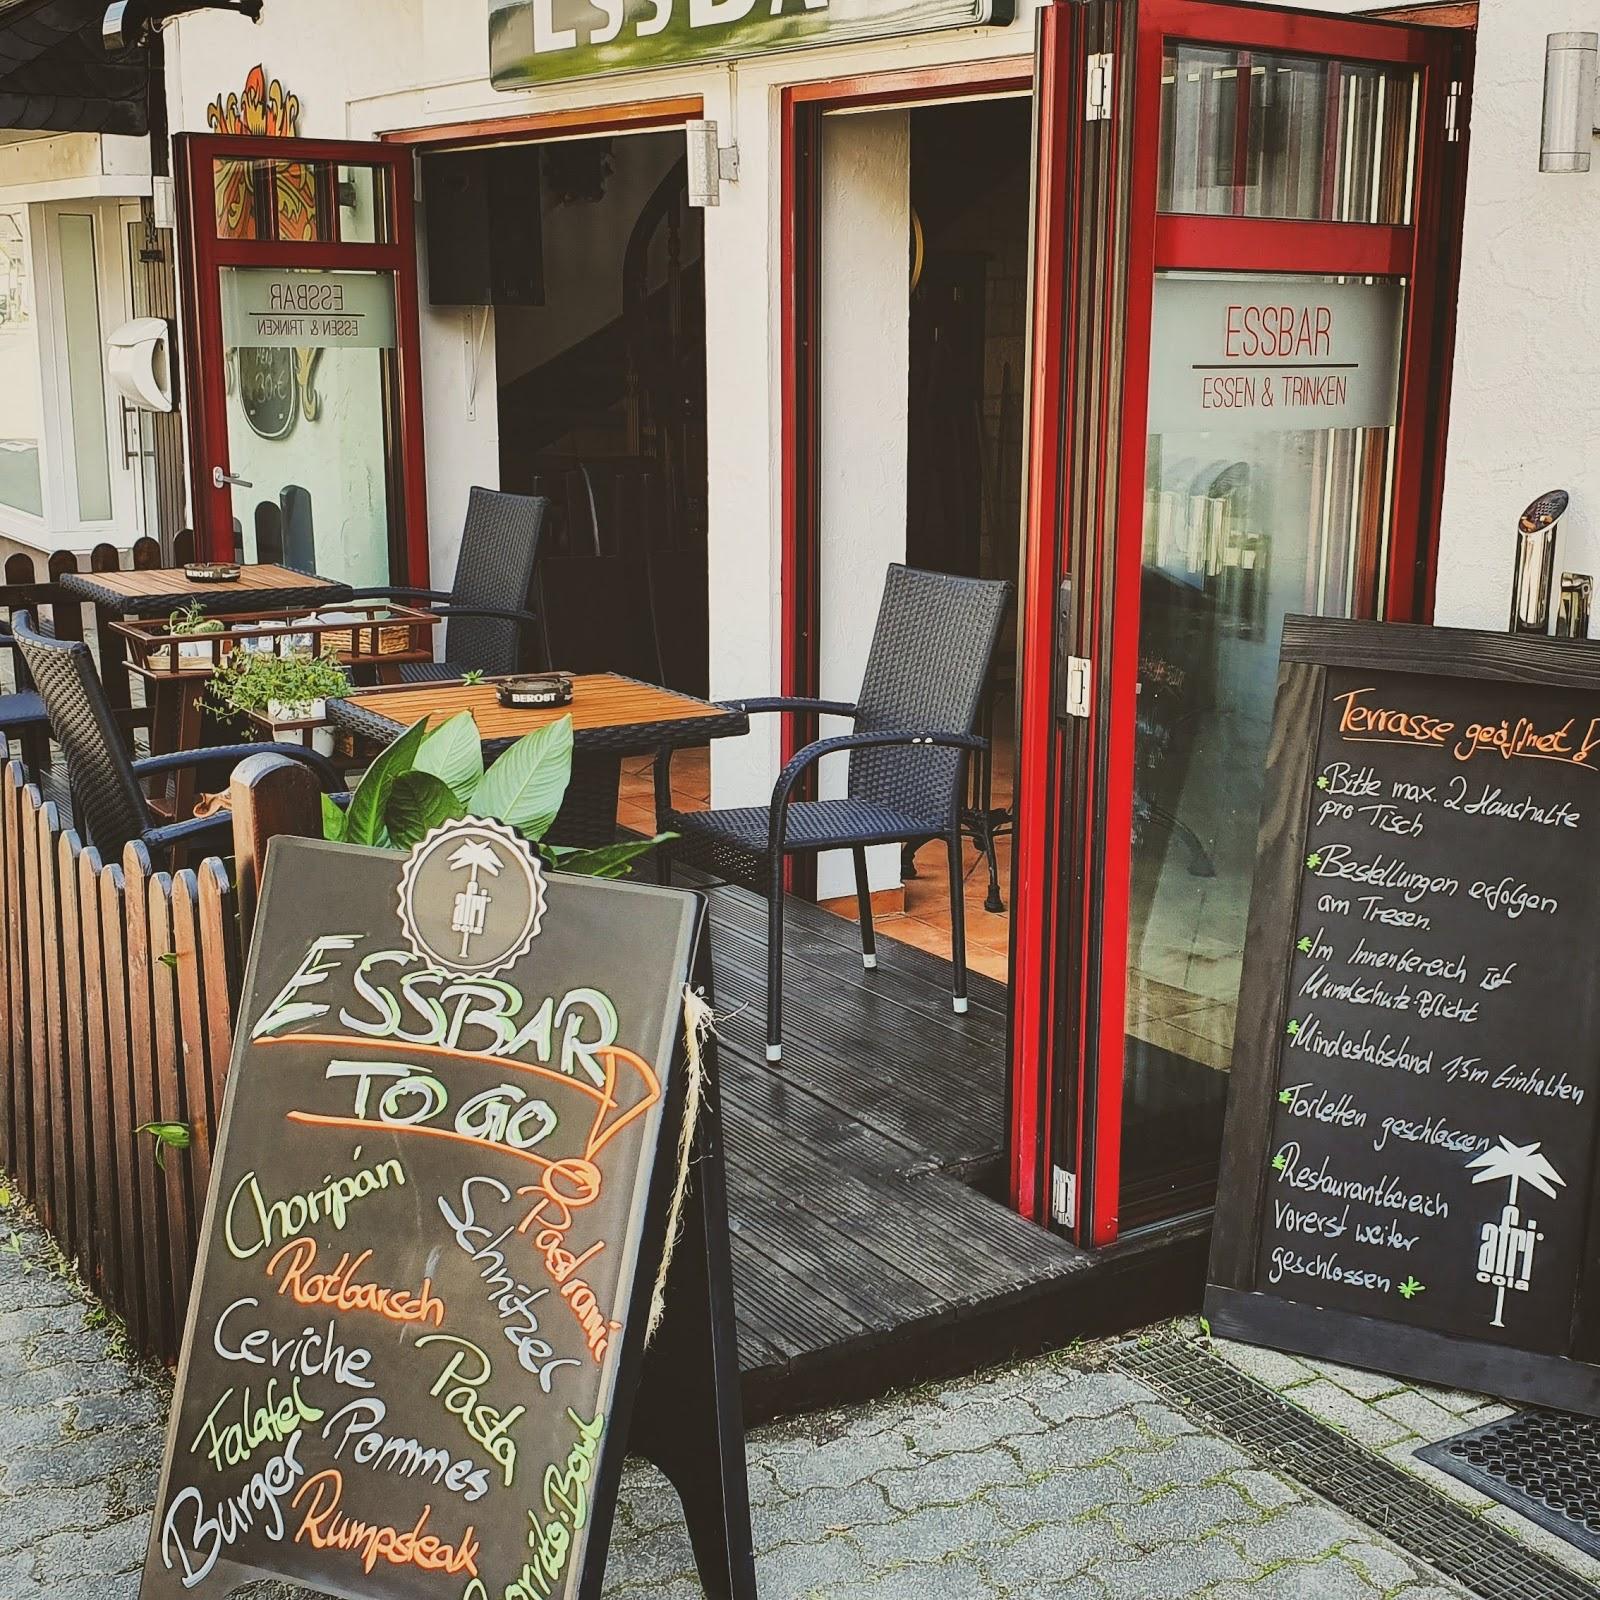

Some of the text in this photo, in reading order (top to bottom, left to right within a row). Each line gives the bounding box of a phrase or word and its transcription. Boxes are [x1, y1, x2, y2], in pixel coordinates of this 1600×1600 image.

[1224, 306, 1332, 357] ESSBAR
[1202, 375, 1347, 409] ESSEN & TRINKEN
[1333, 688, 1454, 741] Terrasse
[1454, 717, 1575, 760] geöffnet
[1316, 800, 1424, 837] pro Tisch
[1323, 762, 1581, 828] Bitte max. 2 Haushalte
[1314, 844, 1558, 919] Bestellungen erfolgen
[1317, 894, 1432, 931] am Tresen.
[1306, 927, 1517, 990] Im Innenbereich ist
[251, 934, 619, 1087] ESSBAR
[1290, 1013, 1433, 1074] Mindestabstand
[326, 1060, 448, 1125] TO
[454, 1085, 558, 1149] GO
[1373, 1116, 1490, 1152] geschlossen
[225, 1145, 406, 1259] Choripán
[1276, 1141, 1449, 1219] Restaurantbereich
[1268, 1247, 1392, 1294] geschlossen
[1355, 1218, 1420, 1251] weiter
[1478, 1205, 1537, 1281] afri
[266, 1237, 444, 1328] Rotbarsch
[438, 1176, 582, 1394] Schnitzel
[1476, 1271, 1529, 1291] cola
[214, 1297, 376, 1389] Ceviche
[190, 1375, 325, 1472] Falafel
[415, 1334, 526, 1487] Pasta
[322, 1397, 490, 1502] Pommes
[162, 1429, 304, 1589] Burger
[291, 1469, 480, 1577] Rumpsteak
